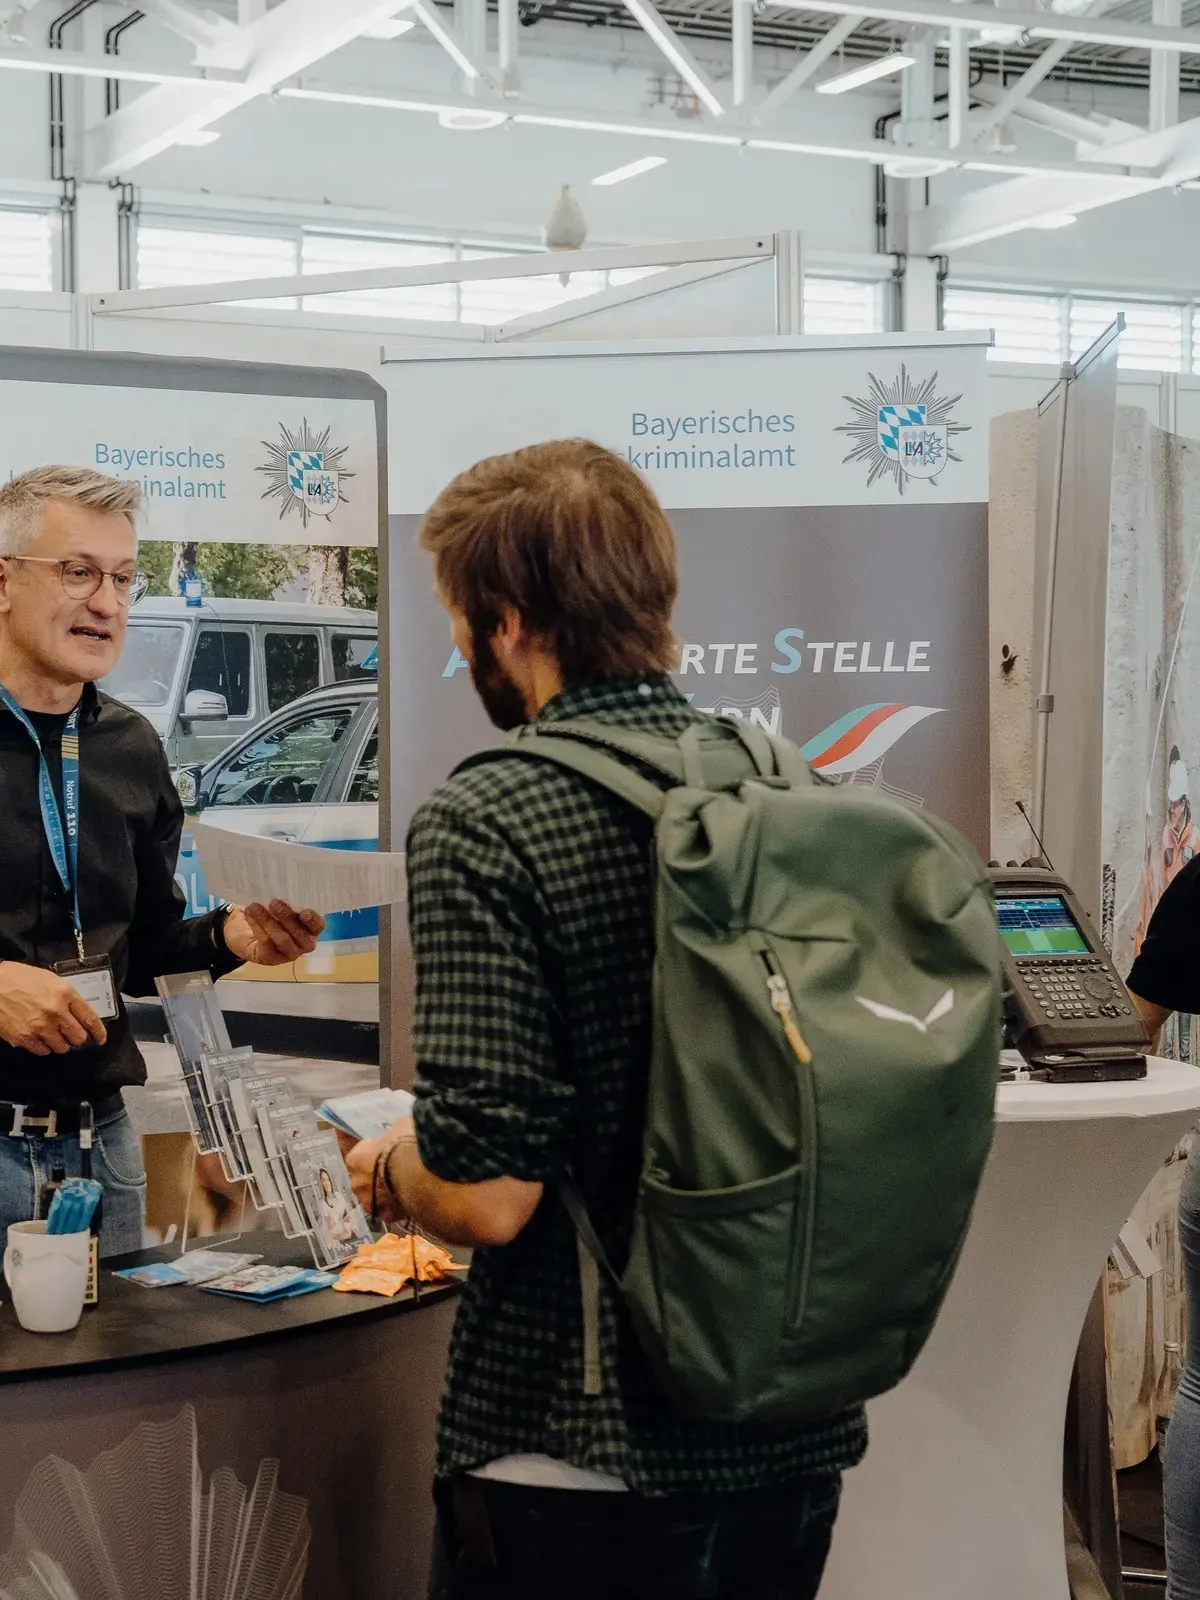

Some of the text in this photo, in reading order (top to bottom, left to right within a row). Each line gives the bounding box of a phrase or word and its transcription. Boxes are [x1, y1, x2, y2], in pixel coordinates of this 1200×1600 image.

[631, 409, 796, 442] Bayerisches
[95, 443, 226, 470] Bayerisches
[626, 442, 796, 470] kriminalamt
[904, 440, 924, 457] LKA
[307, 482, 322, 497] LKA
[770, 627, 932, 675] STELLE
[65, 780, 77, 837] Notruf 110
